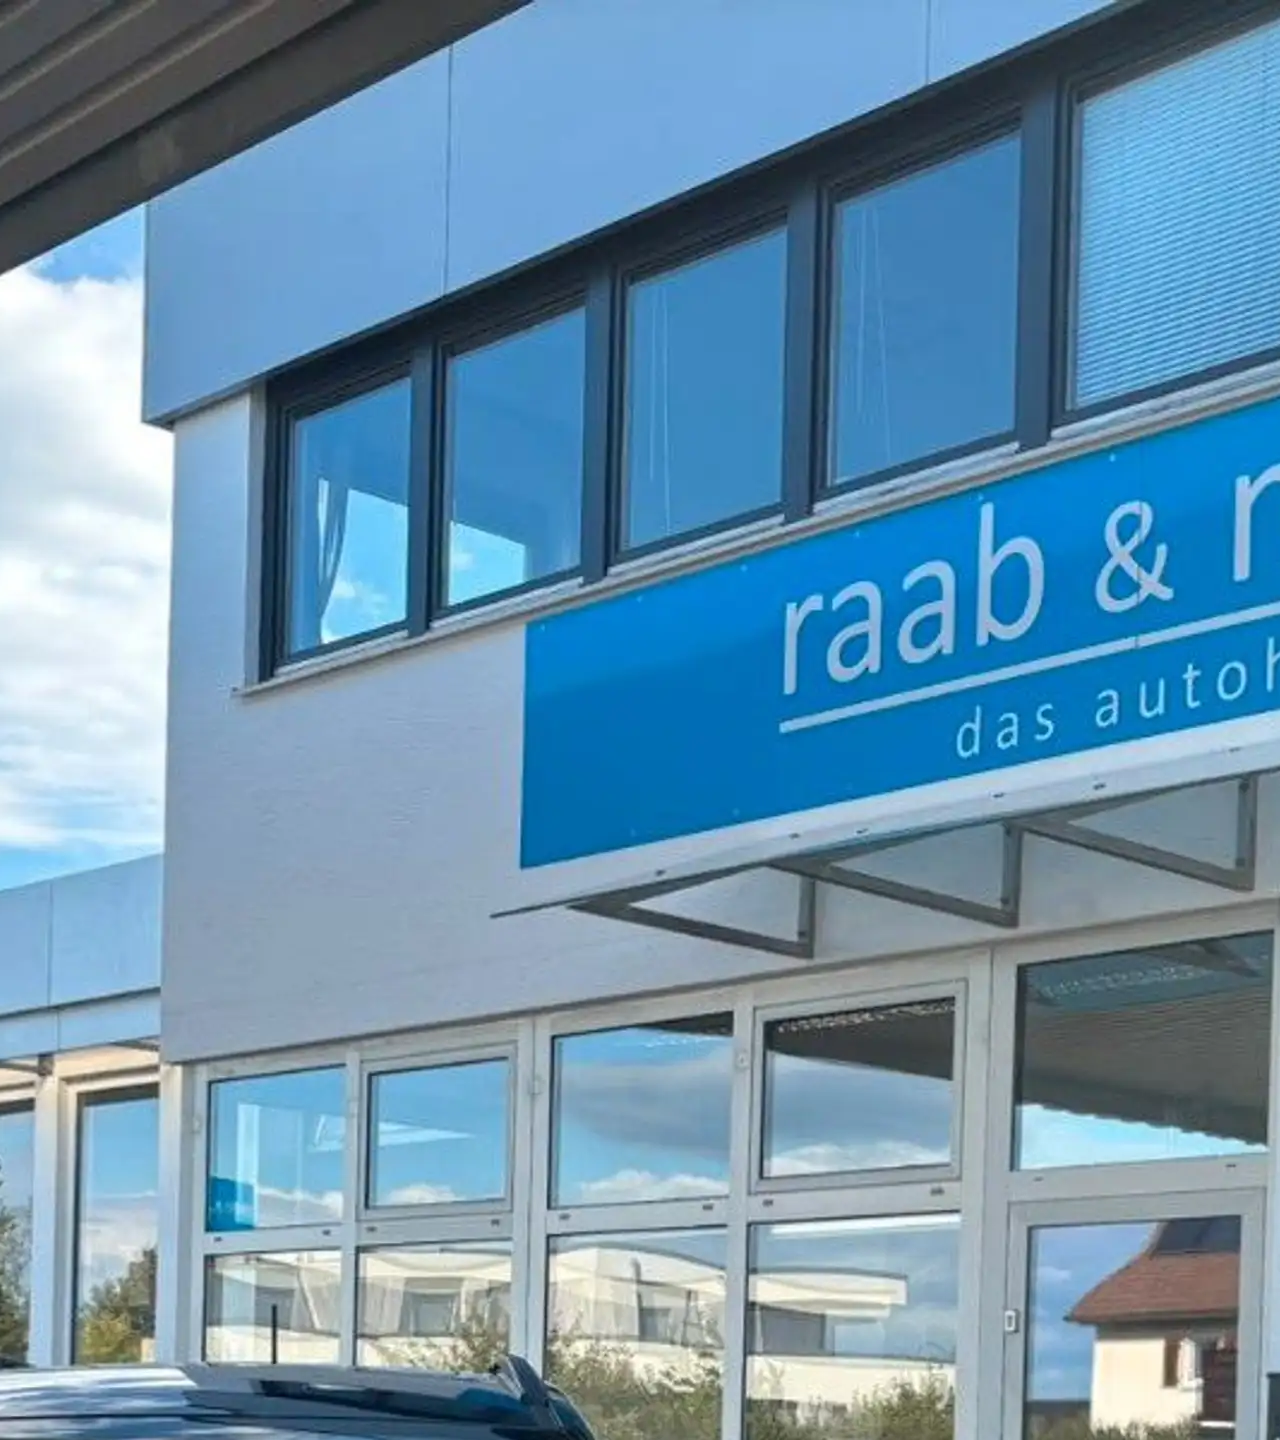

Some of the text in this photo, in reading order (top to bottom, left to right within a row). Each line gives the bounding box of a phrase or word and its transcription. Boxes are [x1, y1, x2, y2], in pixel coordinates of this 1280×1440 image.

[783, 503, 1043, 697] raab
[1096, 500, 1175, 613] &
[957, 694, 1058, 759] das
